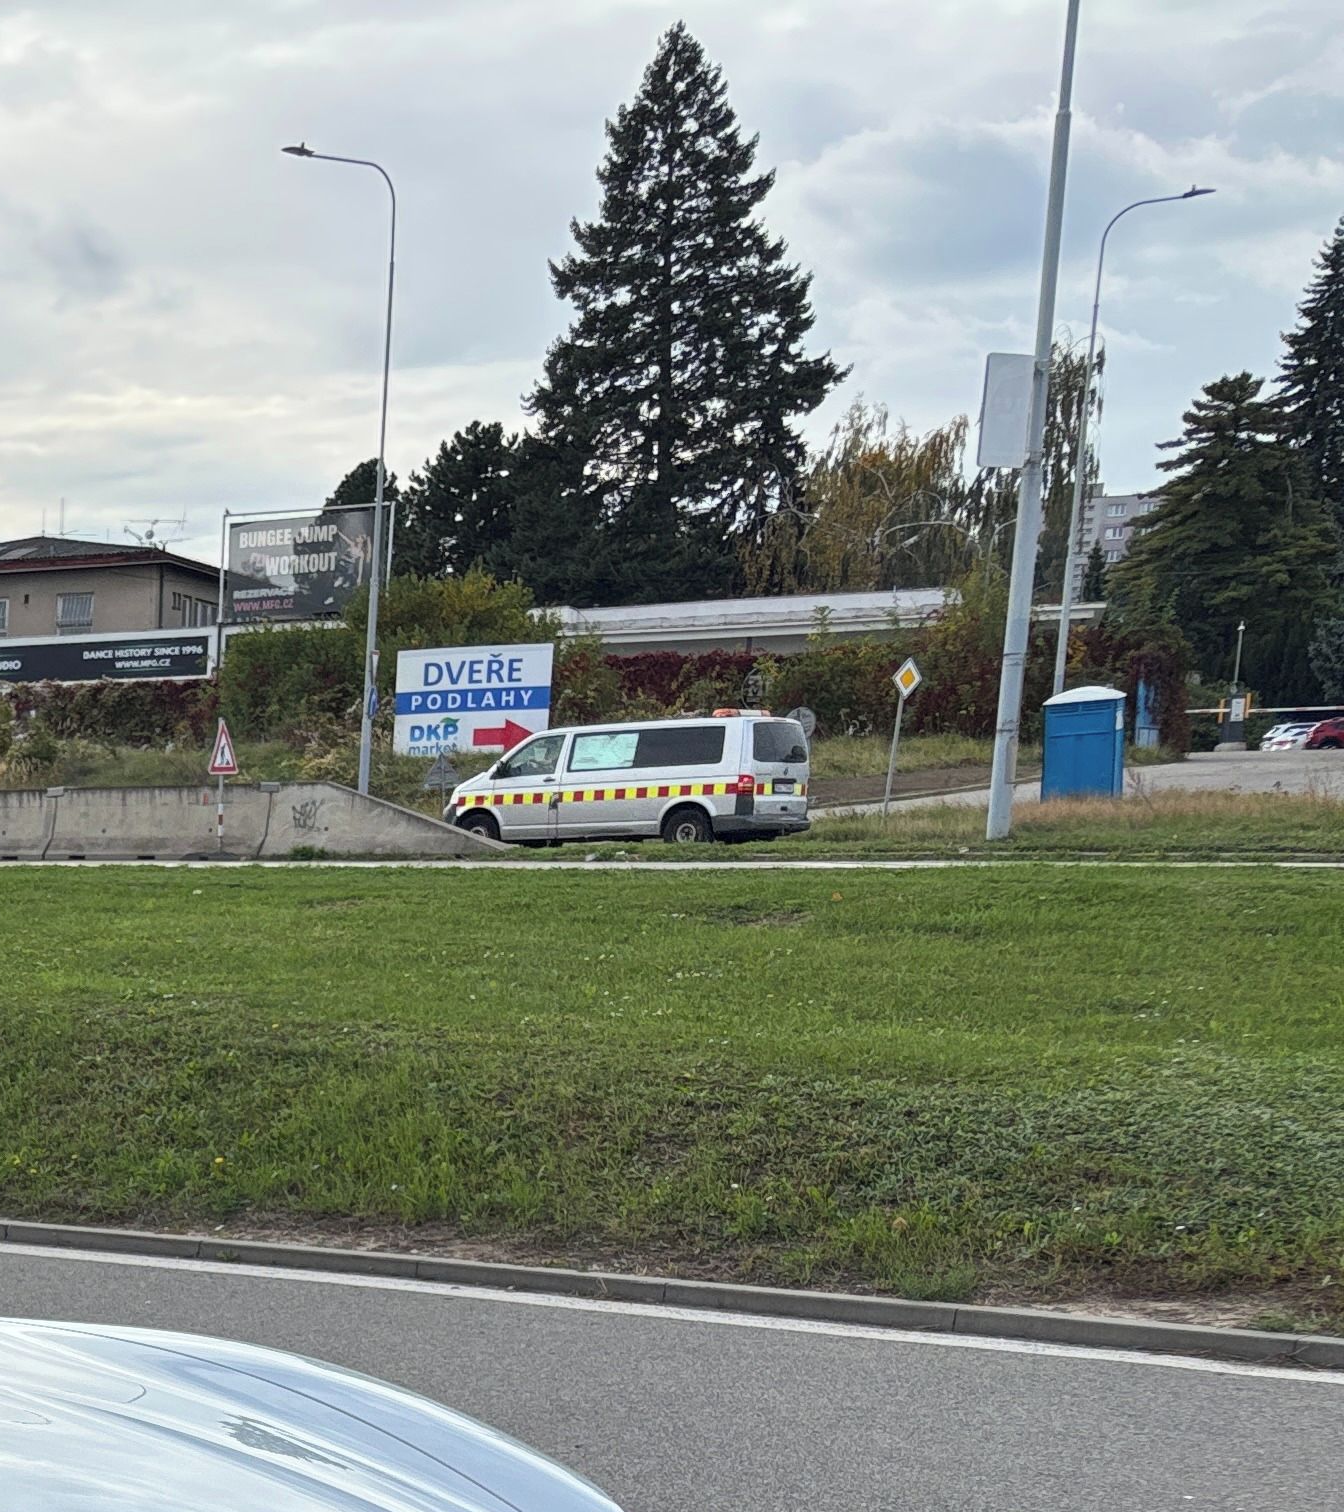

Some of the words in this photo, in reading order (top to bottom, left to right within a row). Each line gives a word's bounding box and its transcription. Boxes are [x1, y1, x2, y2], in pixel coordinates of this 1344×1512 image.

[239, 528, 292, 549] BUNGEE
[295, 524, 338, 544] JUMP
[264, 551, 338, 577] WORKOUT
[233, 598, 294, 612] WWW.MFG.CZ
[82, 649, 114, 660] DANCE
[114, 647, 153, 658] HISTORY
[153, 646, 181, 656] SINCE
[181, 645, 204, 655] 1996
[114, 658, 171, 669] WWW.MFG.CZ
[423, 653, 523, 687] DVEŘE
[410, 689, 533, 712] PODLAHY
[409, 722, 459, 742] DKP
[408, 741, 457, 757] market
